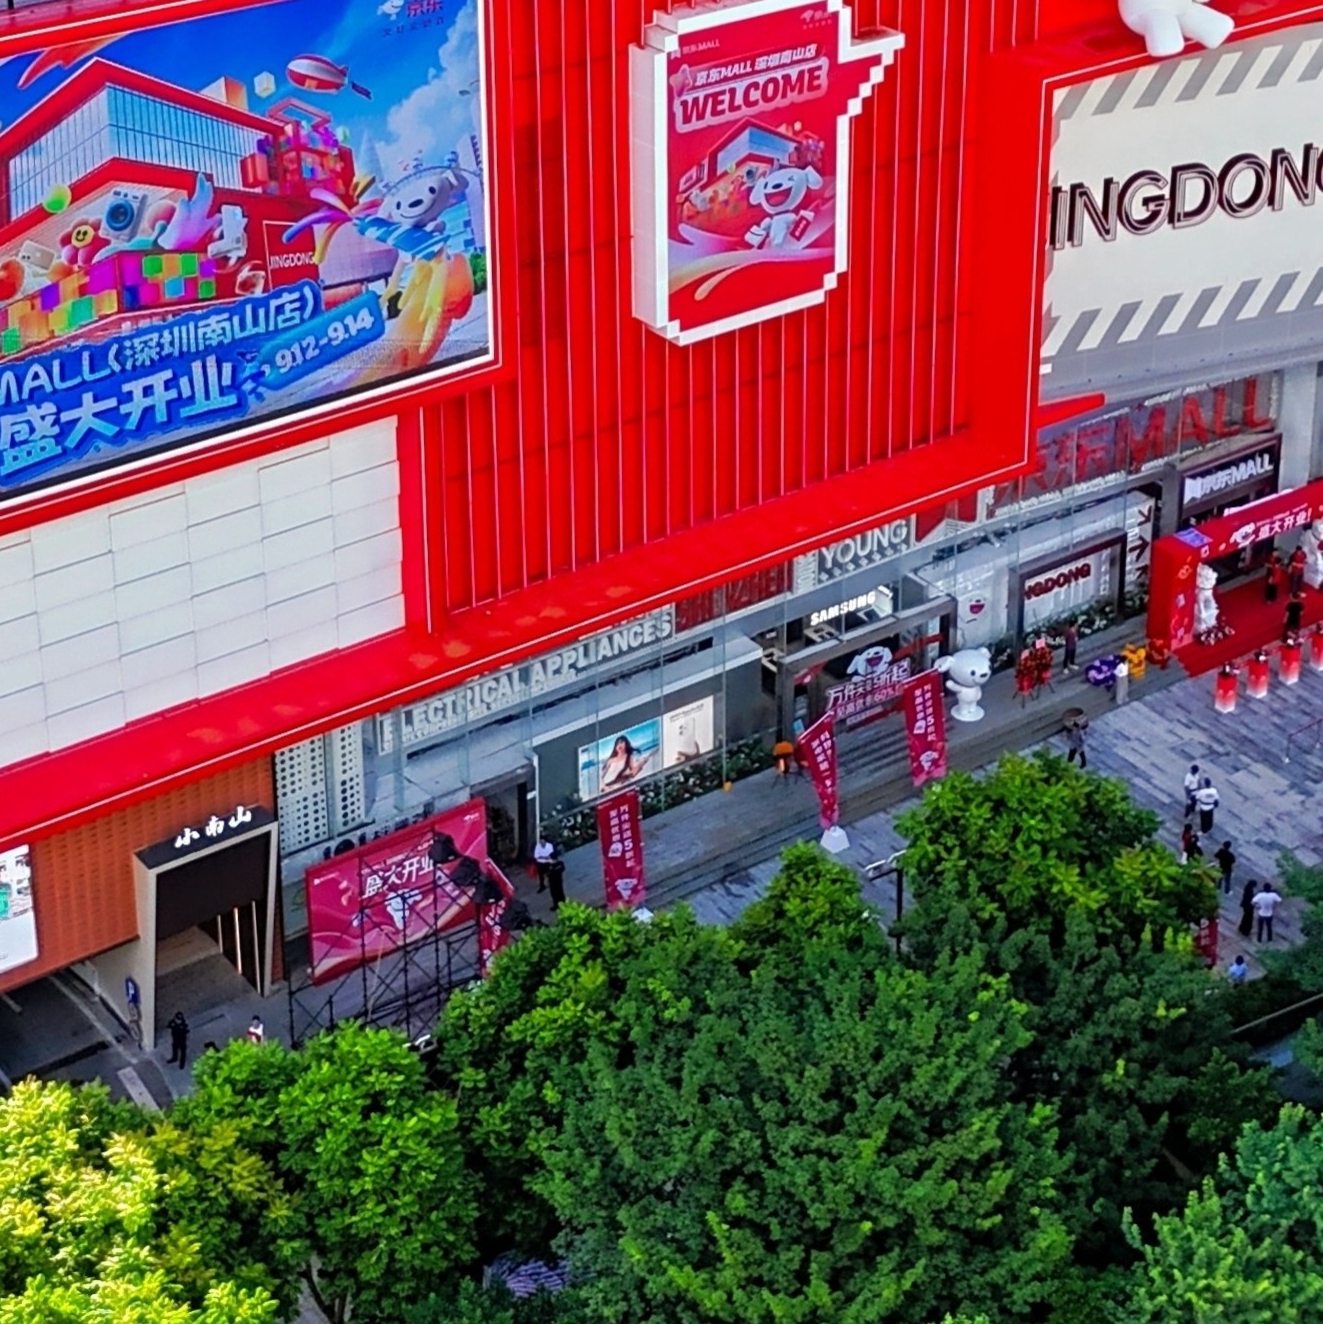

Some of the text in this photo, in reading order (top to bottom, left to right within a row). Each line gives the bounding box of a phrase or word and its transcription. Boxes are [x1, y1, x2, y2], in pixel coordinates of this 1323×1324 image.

[680, 65, 824, 126] WELCOME
[694, 60, 753, 87] 京东MALL
[270, 252, 316, 270] JINGDONG
[819, 518, 908, 569] YOUNG
[809, 590, 877, 626] SAMSUNG
[381, 672, 524, 742] ELECTRICAL
[529, 612, 673, 686] APPLIANCES
[173, 805, 253, 849] 小南山
[364, 853, 436, 899] 盛大开业
